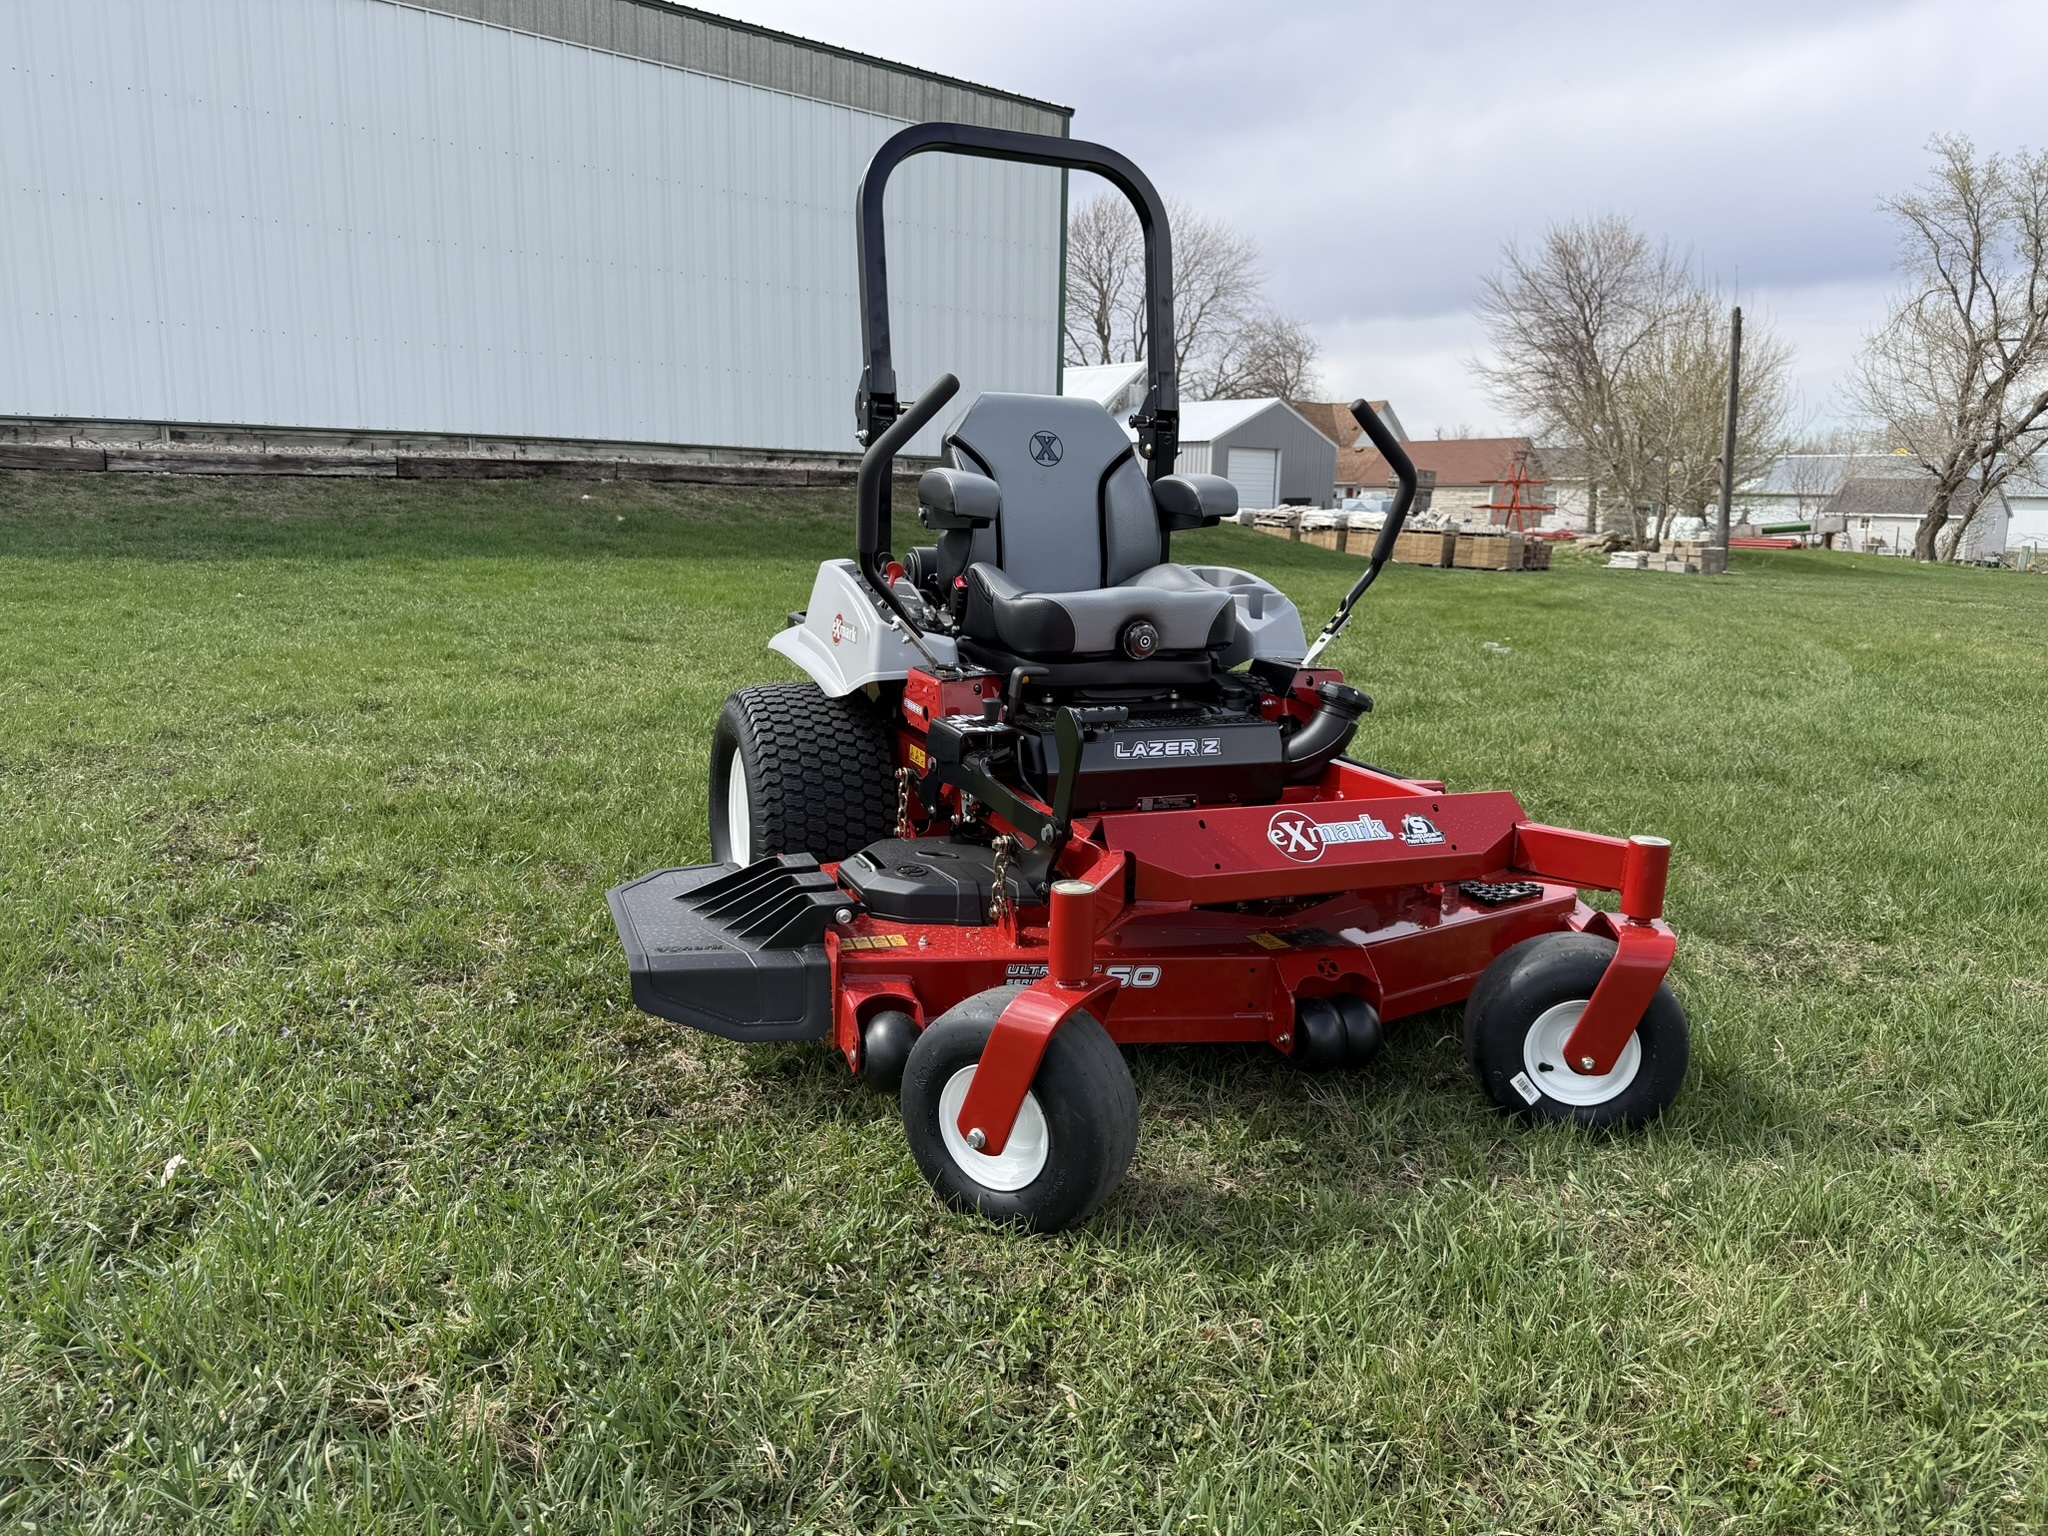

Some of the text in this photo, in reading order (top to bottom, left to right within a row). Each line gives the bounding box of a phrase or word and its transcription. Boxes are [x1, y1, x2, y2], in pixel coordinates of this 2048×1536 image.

[1115, 739, 1219, 758] LAZER Z
[1269, 814, 1390, 853] eXmark
